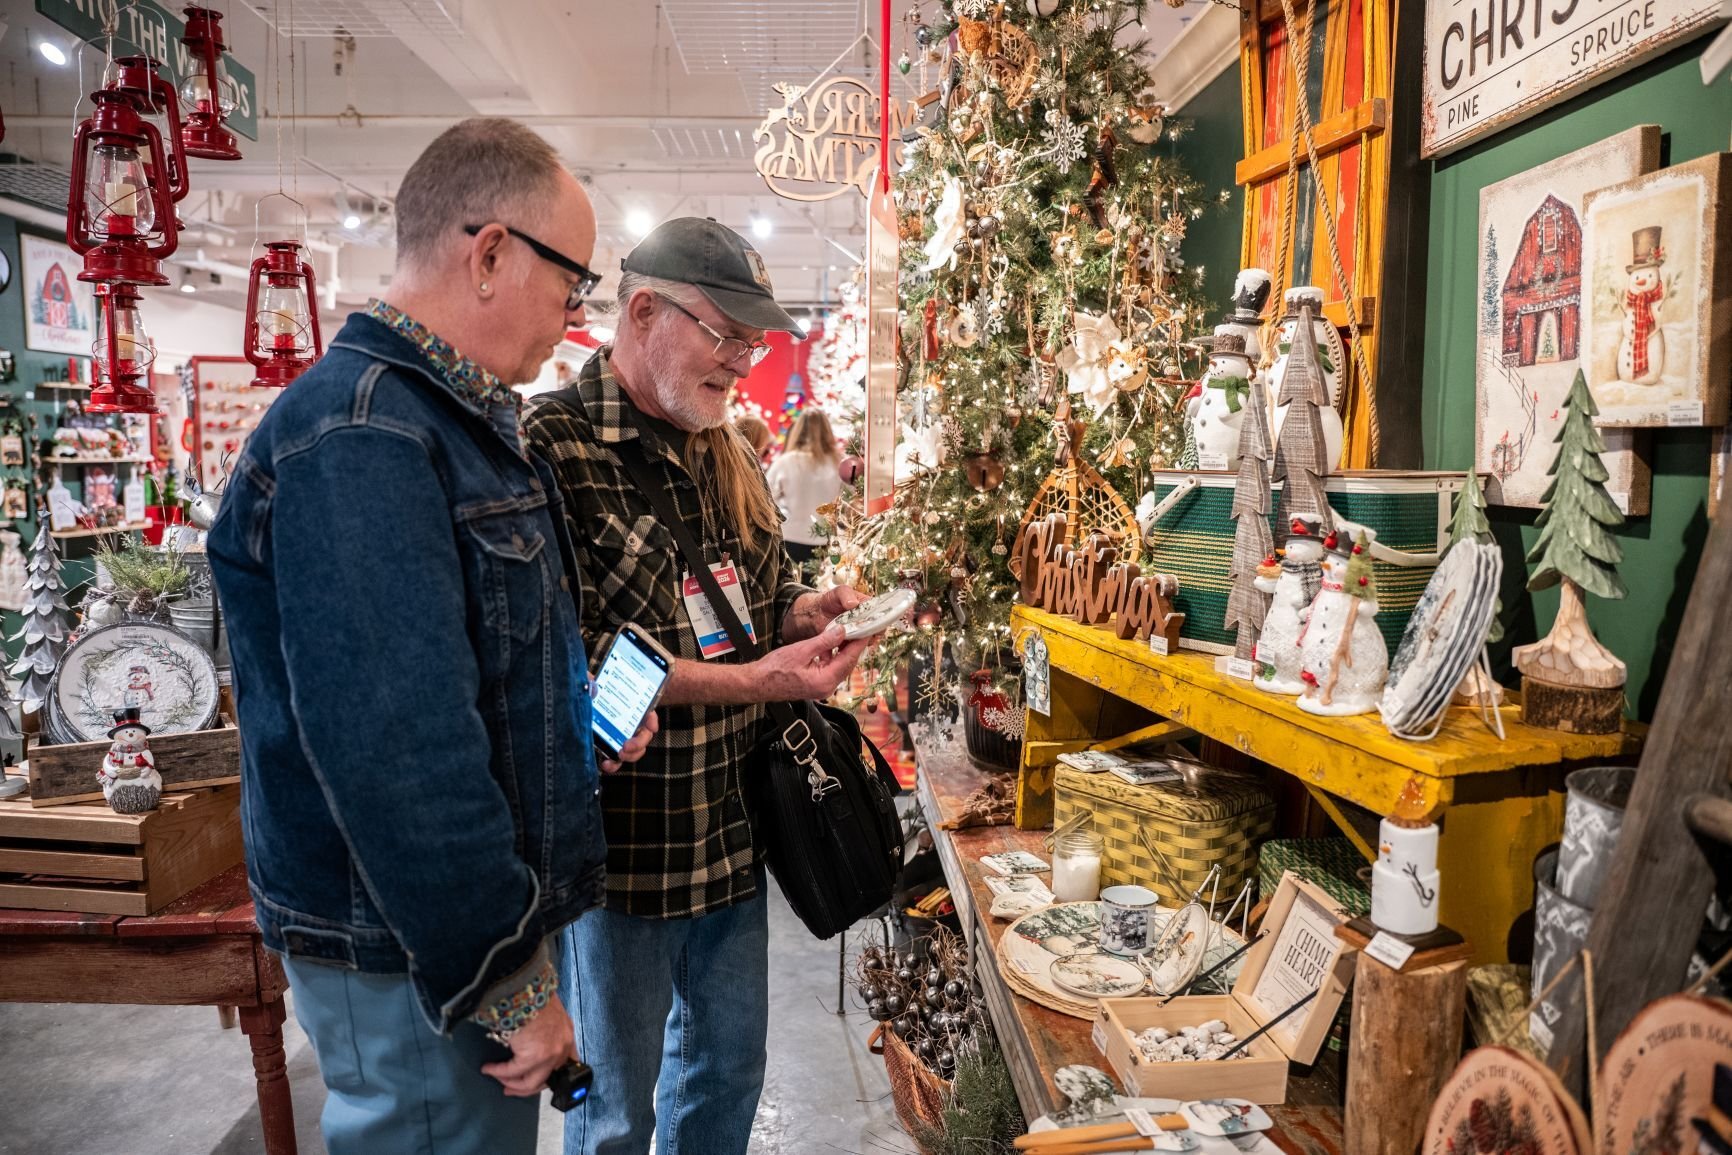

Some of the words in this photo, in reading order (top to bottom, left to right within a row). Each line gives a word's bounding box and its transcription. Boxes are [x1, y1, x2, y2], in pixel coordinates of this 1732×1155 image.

[126, 7, 169, 68] THE
[1570, 3, 1656, 66] SPRUCE
[1447, 94, 1480, 129] PINE
[1021, 513, 1179, 642] Christmas
[1295, 928, 1334, 971] CHIME
[1488, 1063, 1508, 1078] THE
